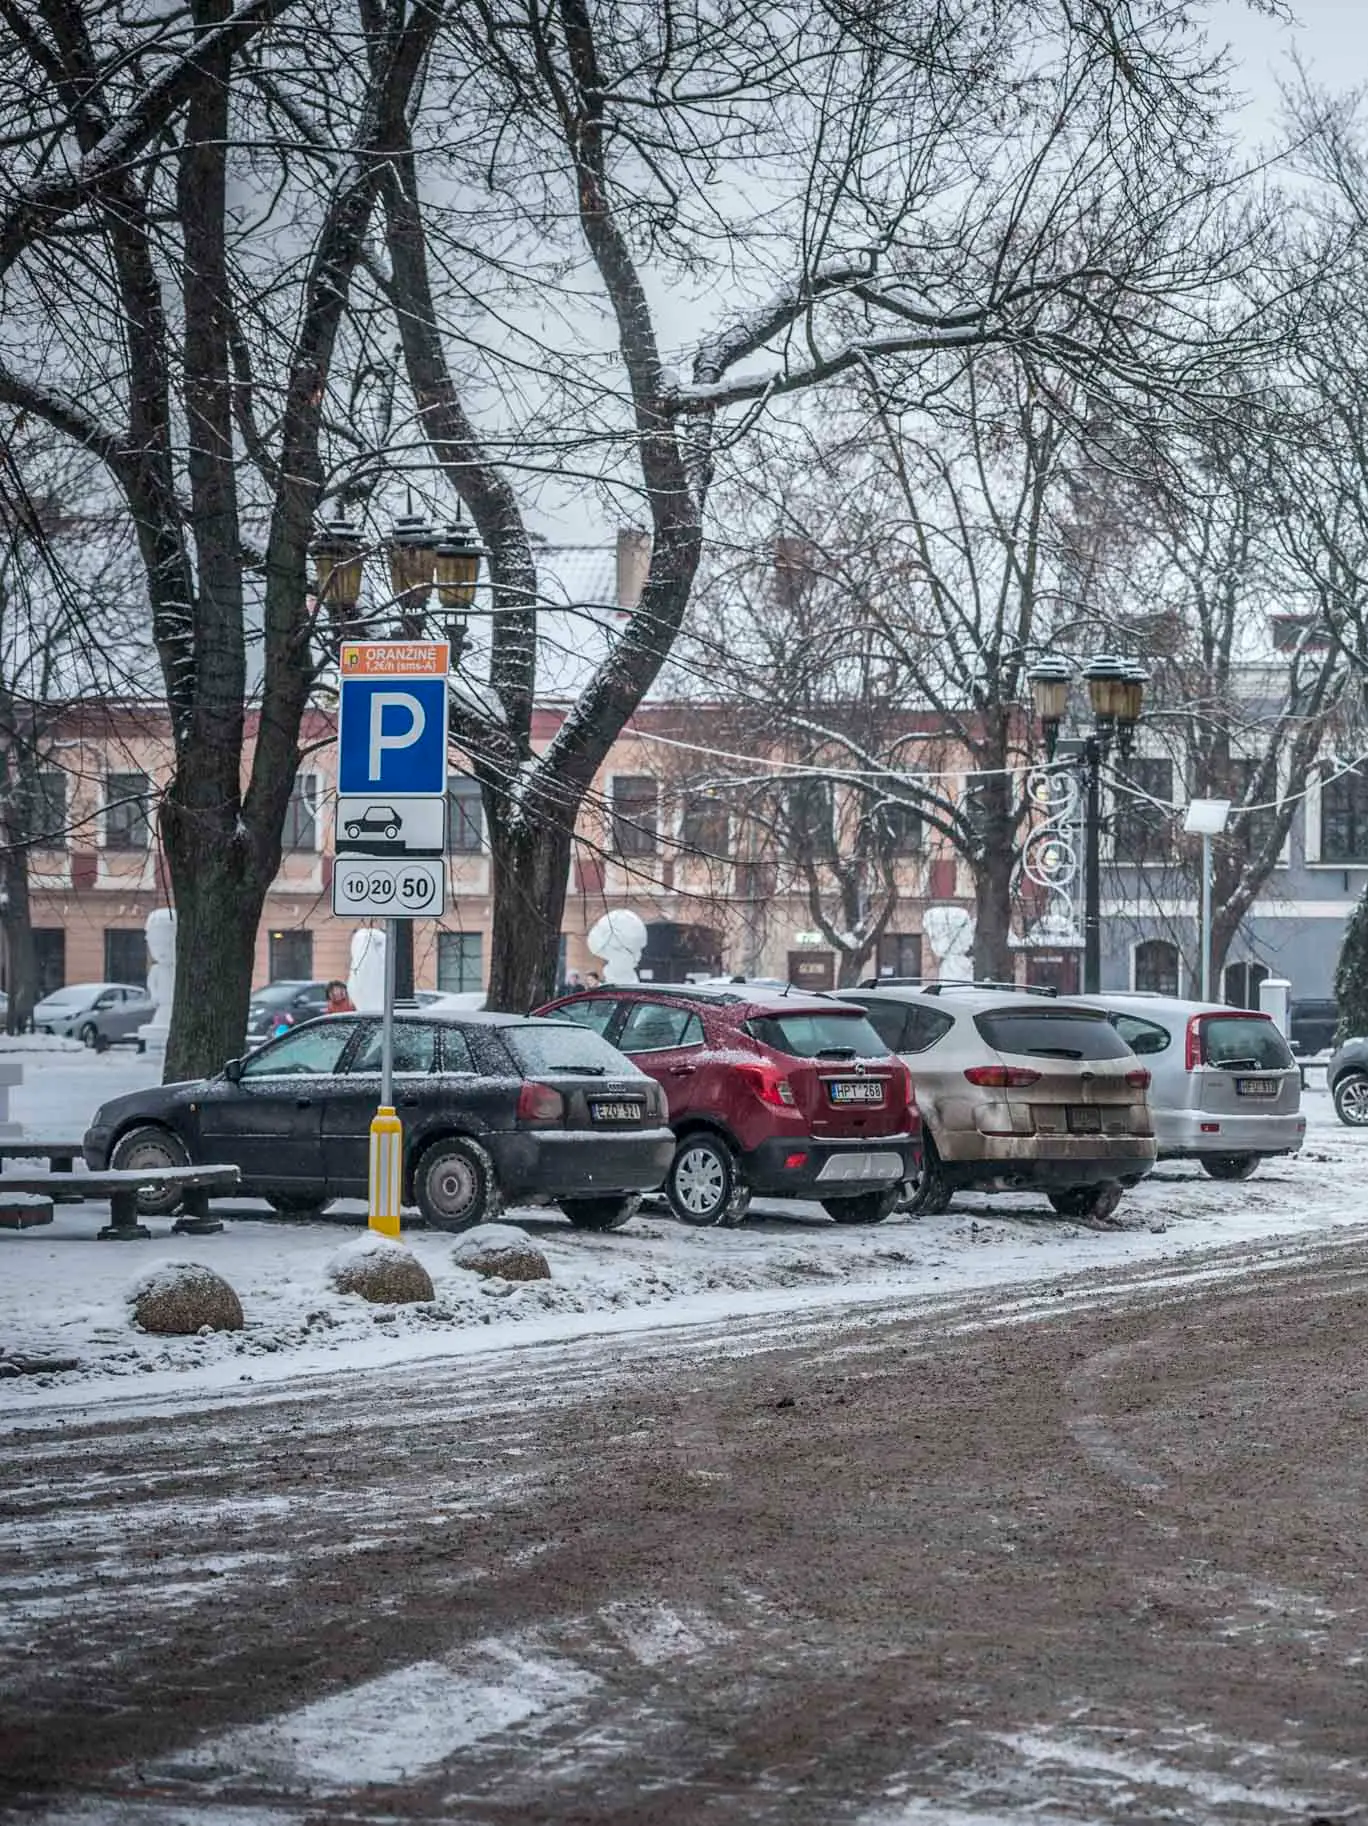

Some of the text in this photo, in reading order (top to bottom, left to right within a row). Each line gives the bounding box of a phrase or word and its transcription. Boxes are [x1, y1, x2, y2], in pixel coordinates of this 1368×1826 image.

[368, 691, 426, 781] P
[347, 878, 428, 898] 10 20 50
